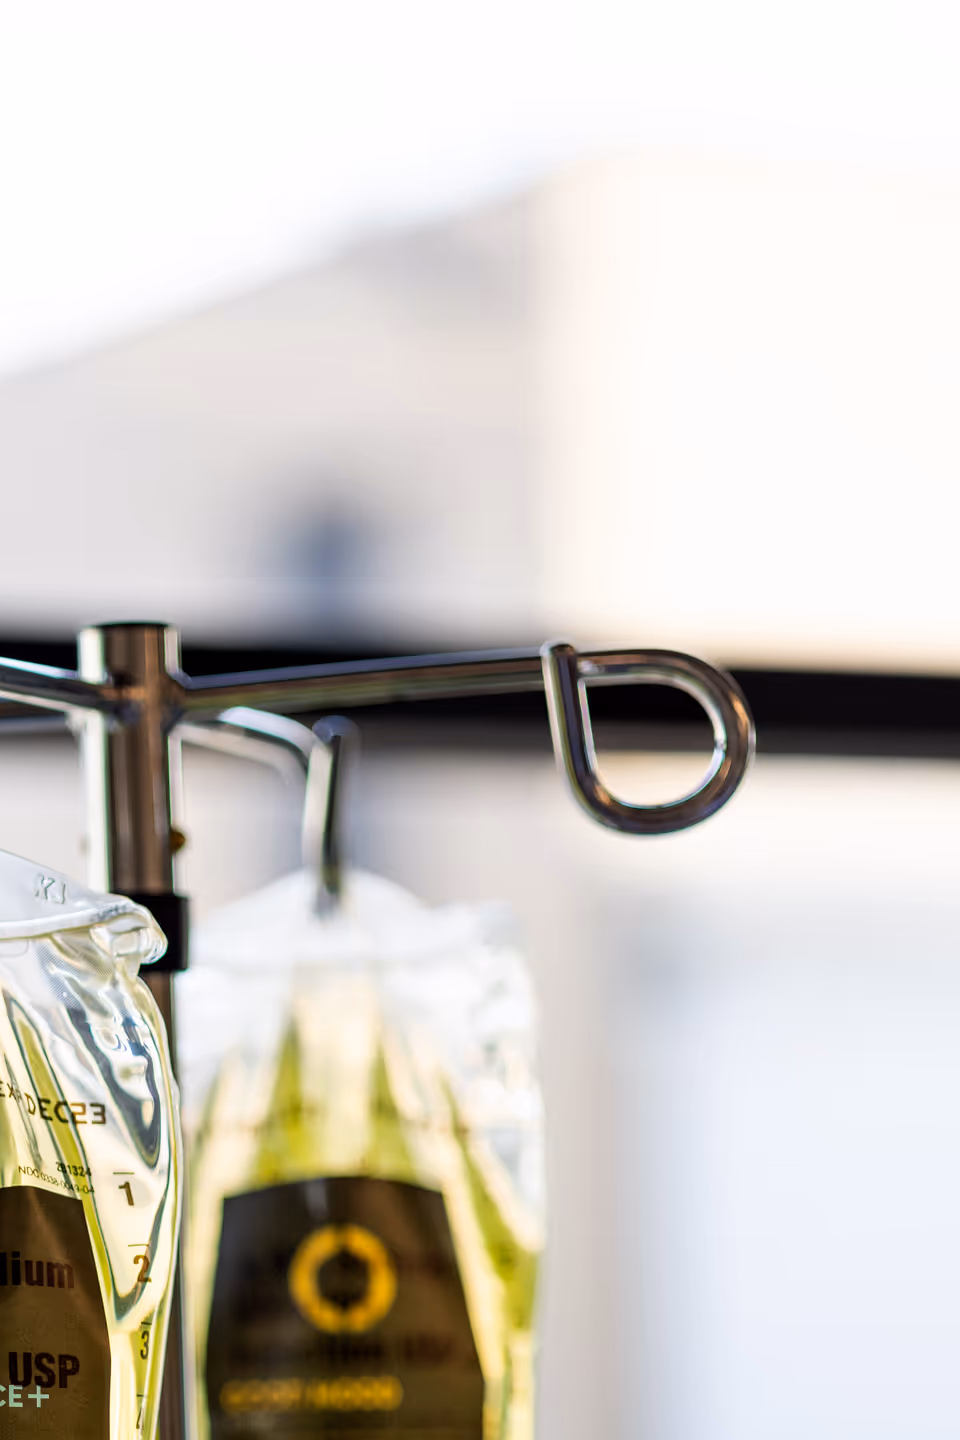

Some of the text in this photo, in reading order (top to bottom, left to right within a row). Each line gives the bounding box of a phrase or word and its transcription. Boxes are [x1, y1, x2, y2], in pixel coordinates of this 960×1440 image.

[118, 1180, 135, 1207] 1
[133, 1254, 151, 1283] 2
[140, 1330, 149, 1361] 3
[8, 1351, 81, 1389] USP
